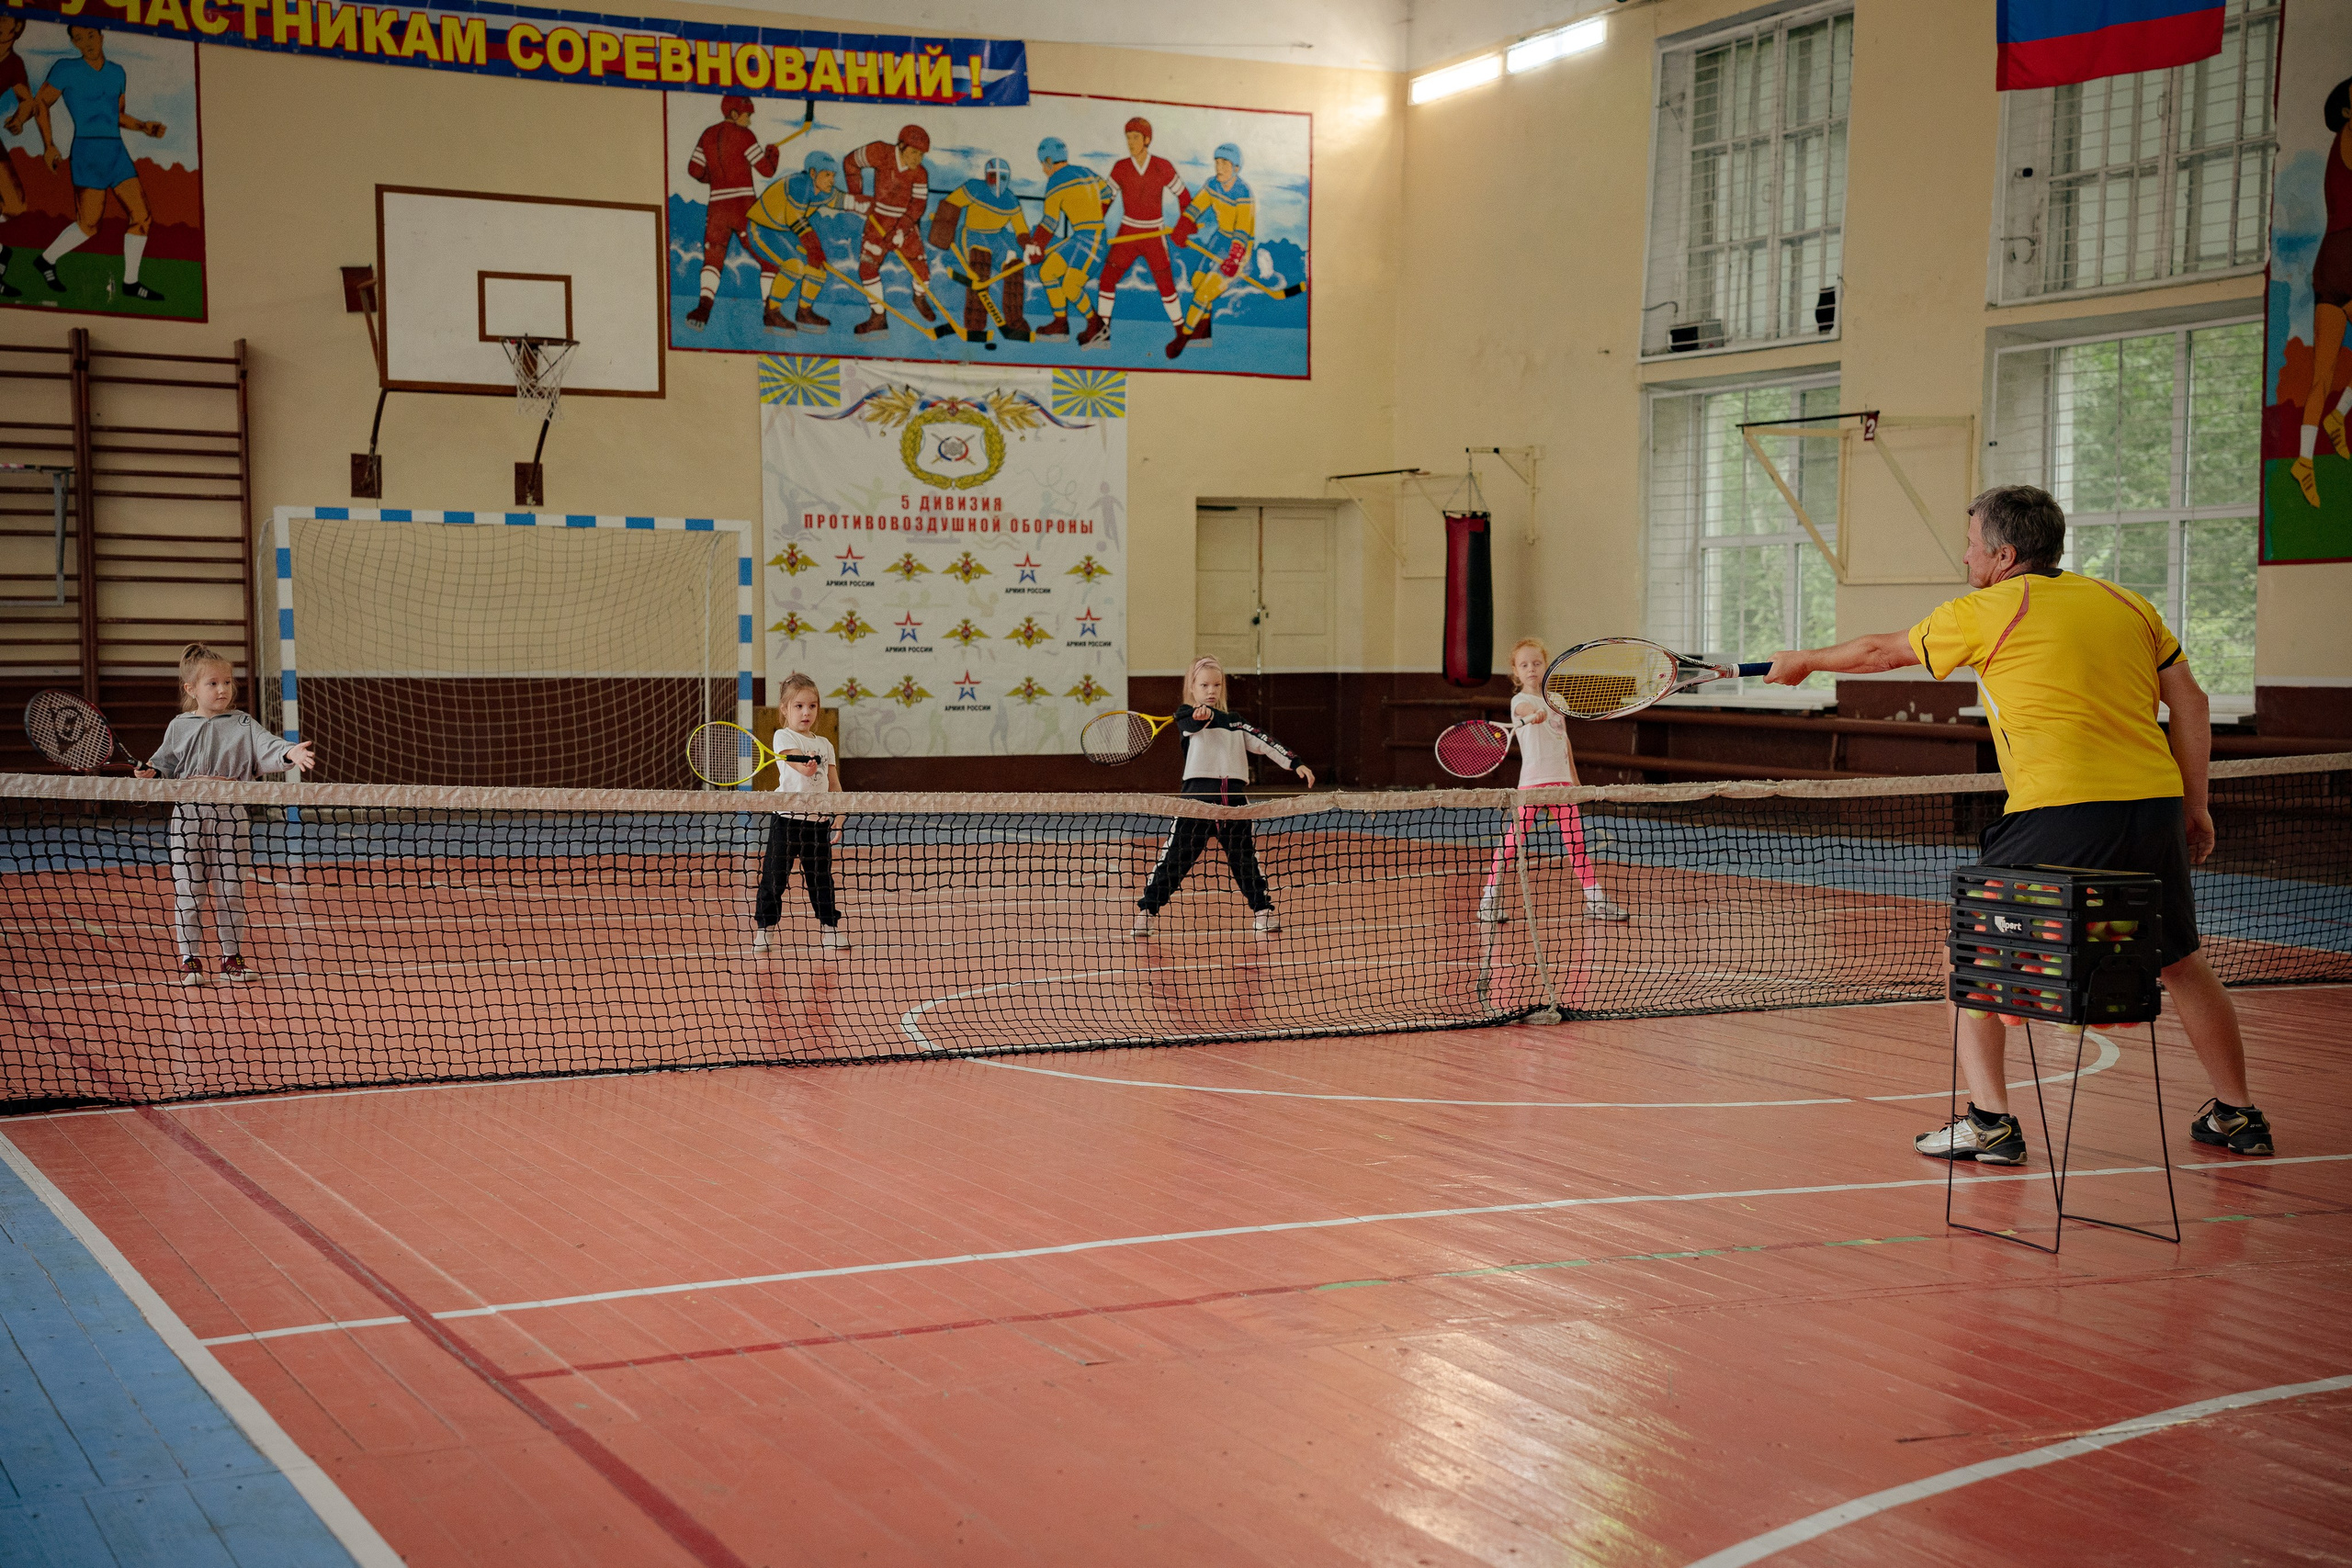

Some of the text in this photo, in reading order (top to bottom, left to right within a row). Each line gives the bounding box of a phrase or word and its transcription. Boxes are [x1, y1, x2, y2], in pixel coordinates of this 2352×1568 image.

[507, 23, 953, 98] СОРЕВНОВАНИЙ
[969, 56, 982, 98] !
[1865, 419, 1875, 439] 2
[901, 495, 1001, 512] 5 ДИВИЗИЯ
[804, 513, 1093, 534] ПРОТИВОВОЗДУШНОЙ ОБОРОНЫ
